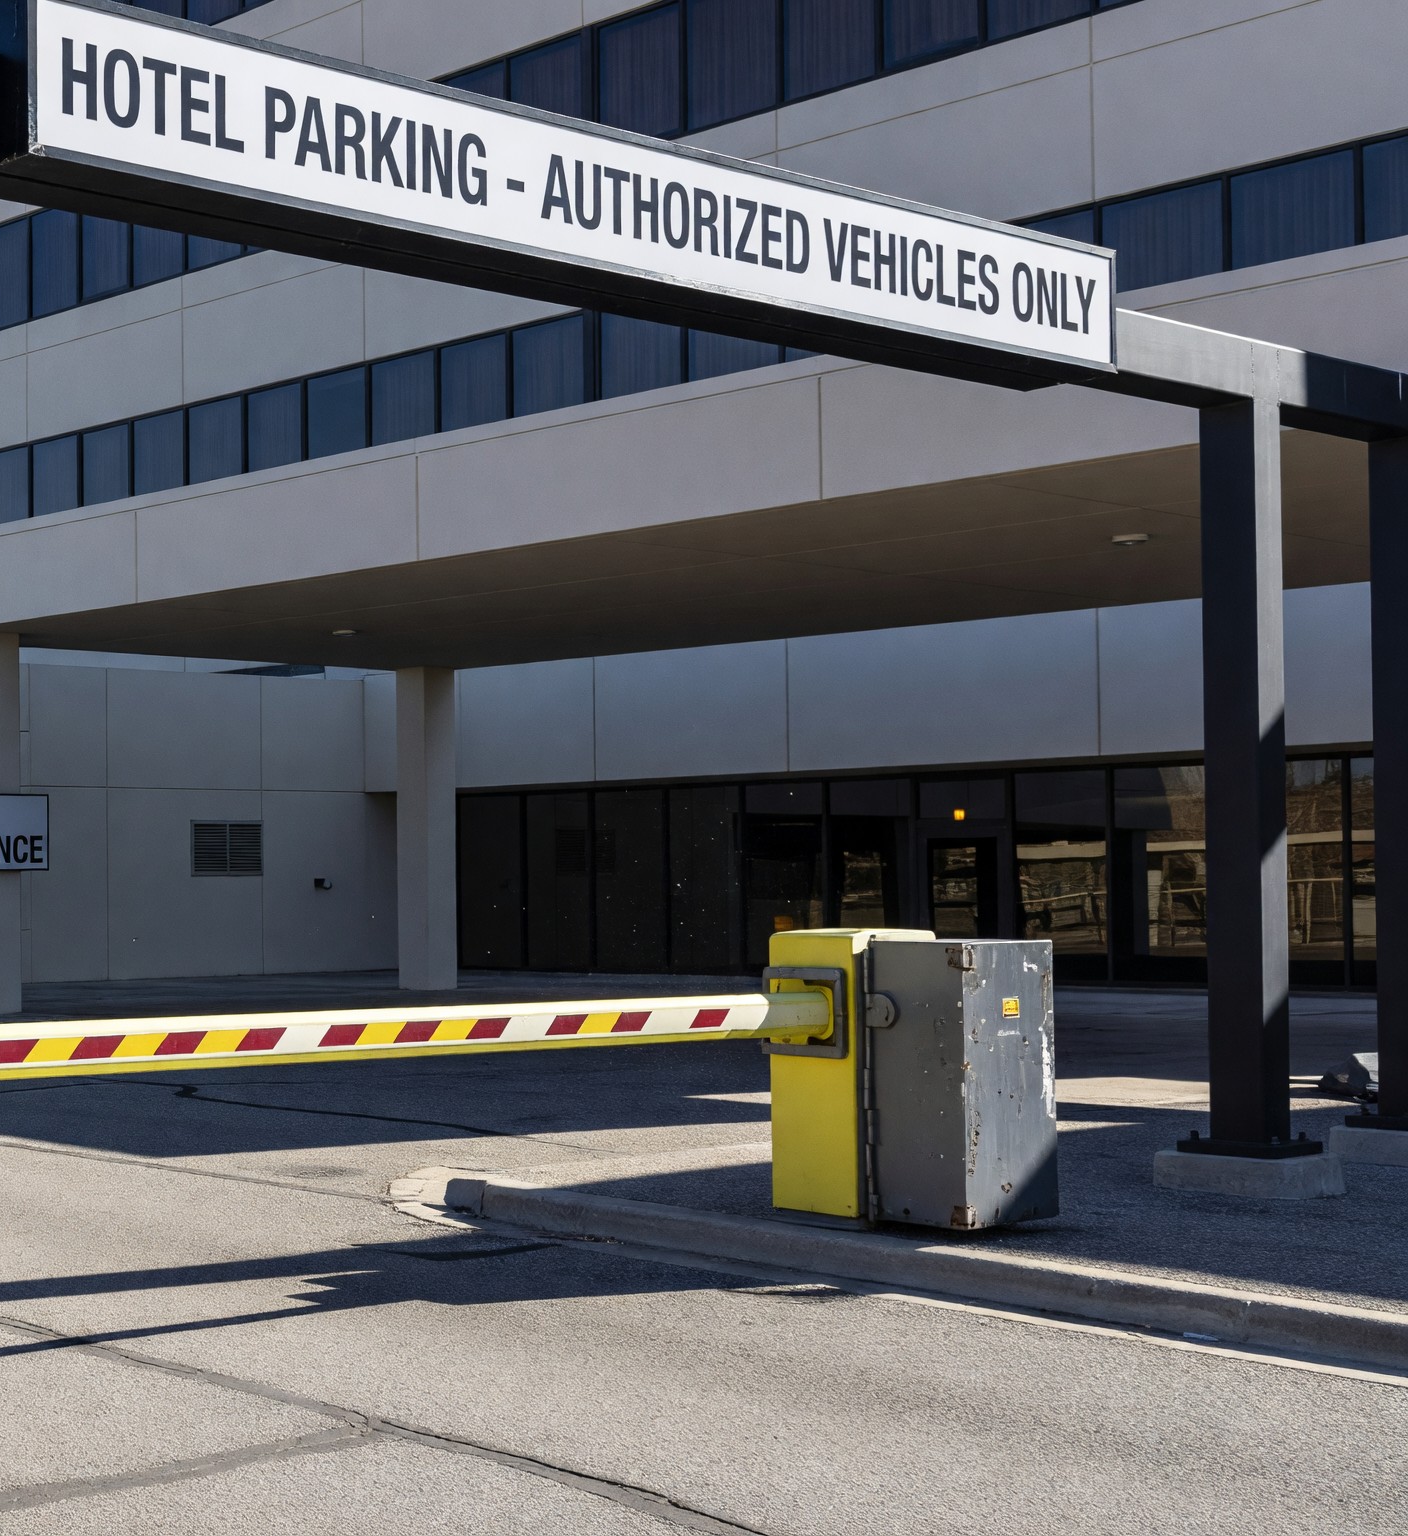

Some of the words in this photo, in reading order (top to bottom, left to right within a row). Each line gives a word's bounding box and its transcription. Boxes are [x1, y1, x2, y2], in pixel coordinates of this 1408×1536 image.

[61, 37, 245, 154] HOTEL
[264, 86, 488, 207] PARKING
[506, 178, 525, 193] -
[540, 154, 810, 274] AUTHORIZED
[823, 218, 1000, 316] VEHICLES
[1012, 262, 1096, 335] ONLY
